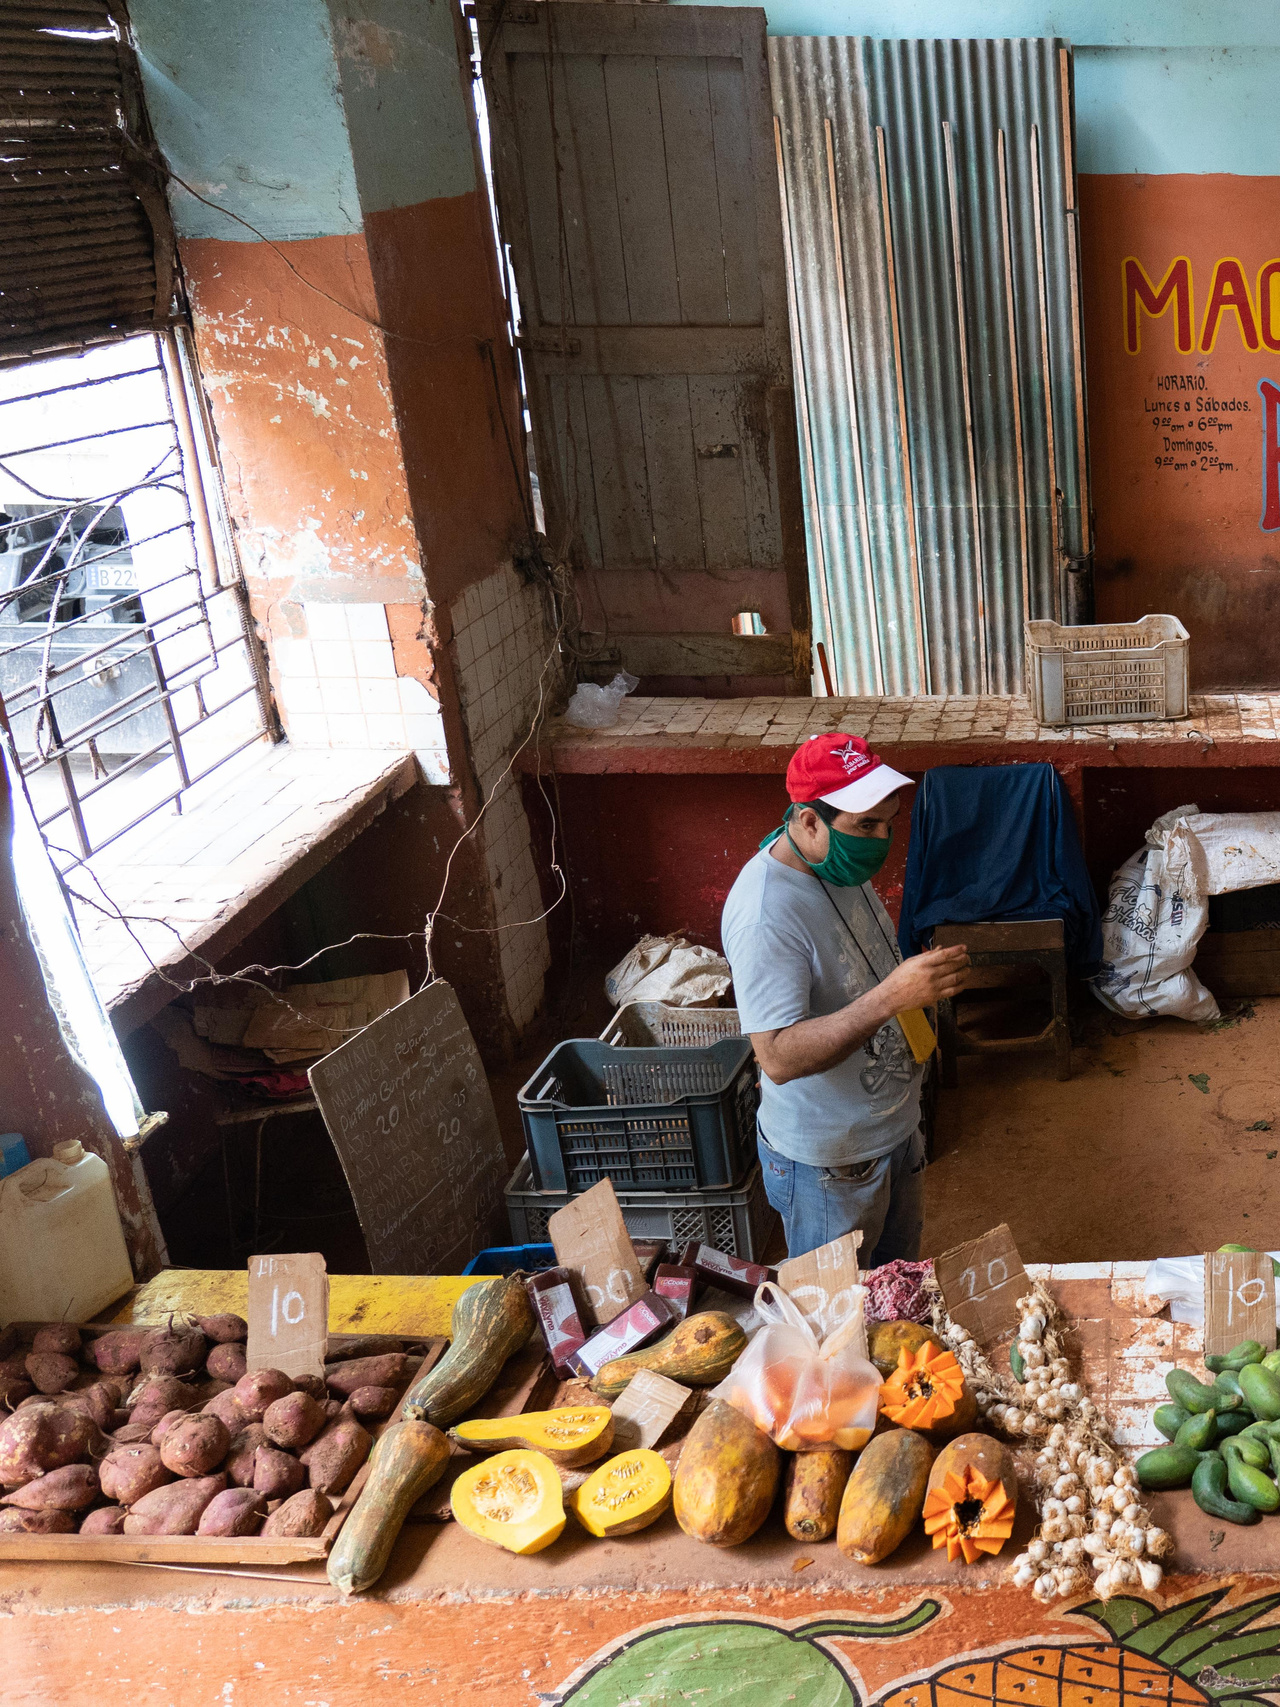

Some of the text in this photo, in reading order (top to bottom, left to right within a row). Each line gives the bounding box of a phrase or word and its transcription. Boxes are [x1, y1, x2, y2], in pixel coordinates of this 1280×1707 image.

[1144, 397, 1251, 412] Lunes a Sábados.
[438, 1116, 460, 1145] 20
[815, 1240, 844, 1271] LB
[271, 1285, 305, 1337] 10
[1227, 1266, 1266, 1327] 10
